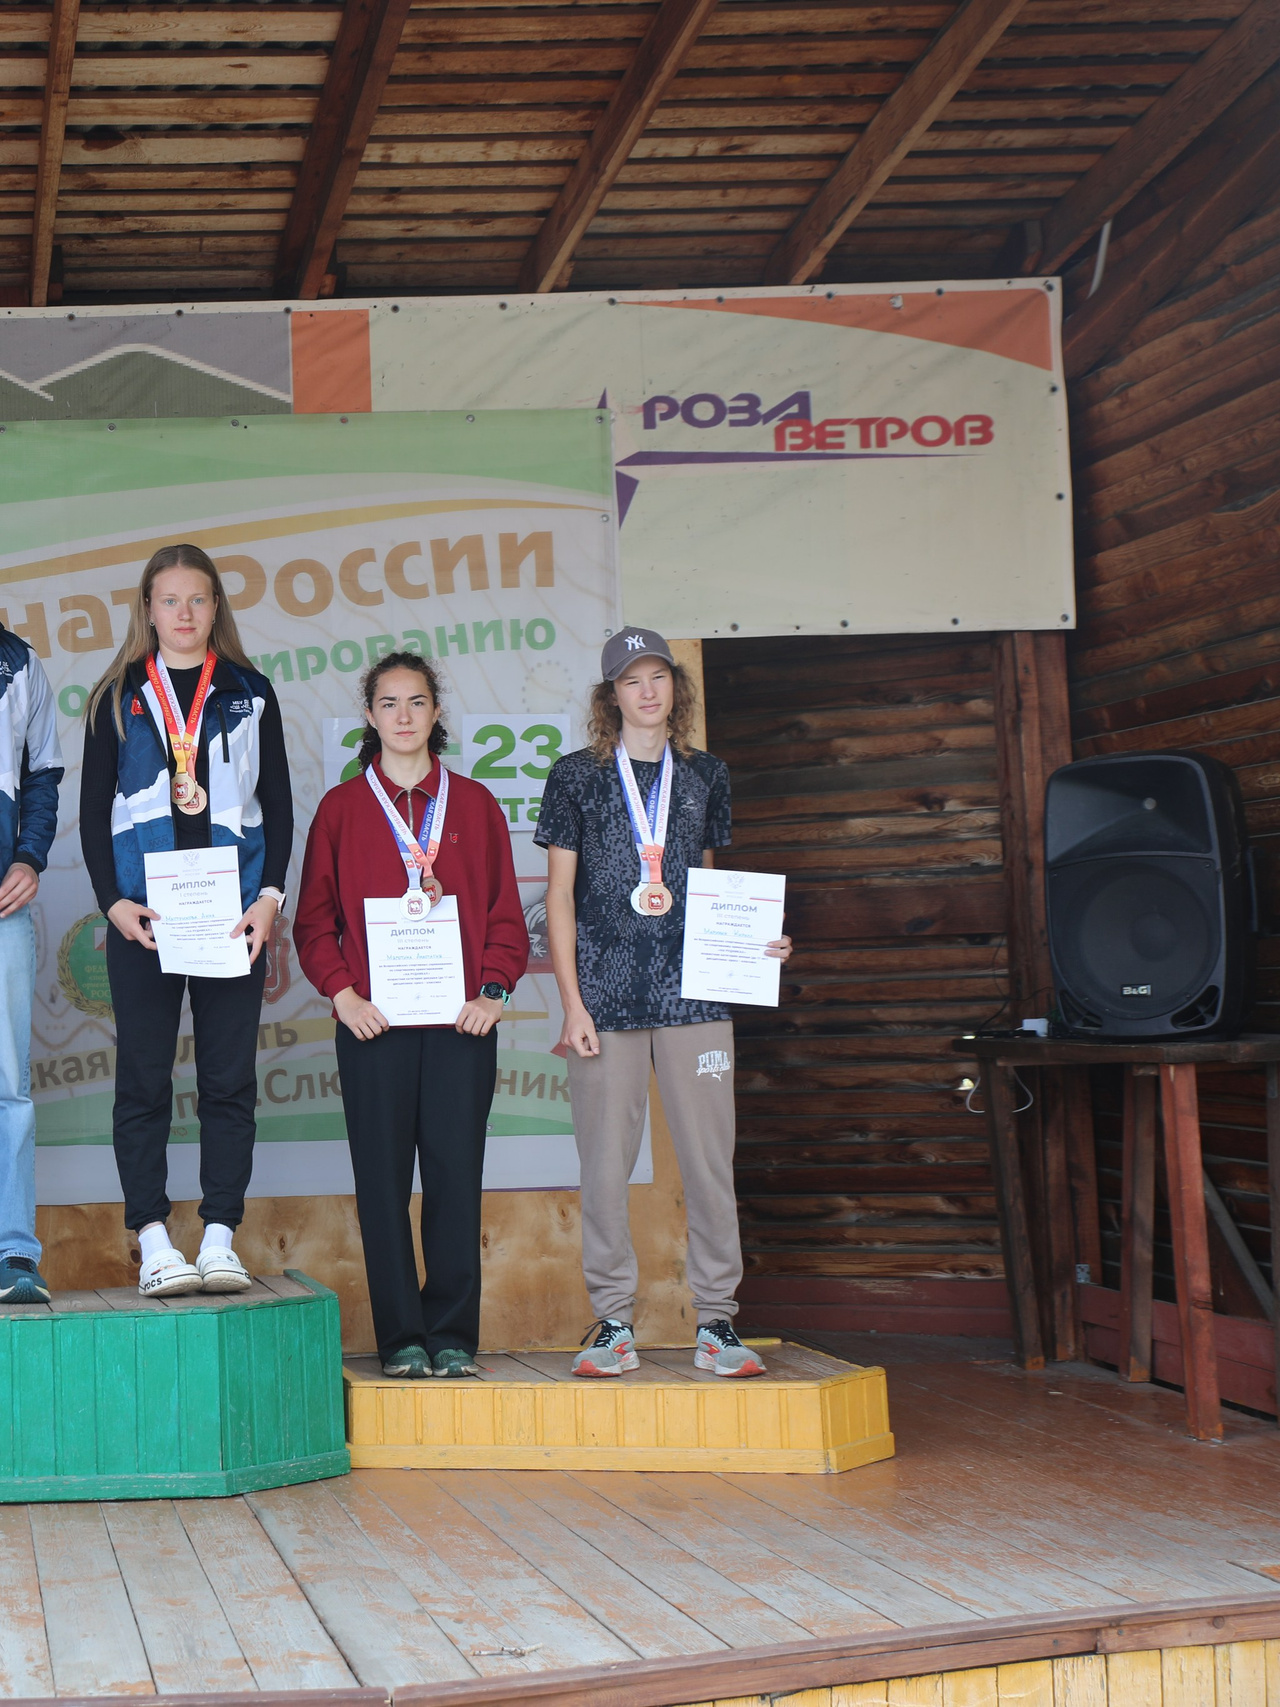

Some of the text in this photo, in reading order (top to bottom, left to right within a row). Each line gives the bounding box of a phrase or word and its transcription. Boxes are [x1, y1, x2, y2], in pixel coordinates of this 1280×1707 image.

[643, 391, 811, 430] РОЗА
[774, 414, 994, 451] ВЕТРОВ
[470, 723, 563, 781] 23
[171, 879, 216, 891] ДИПЛОМ
[710, 902, 758, 913] ДИПЛОМ
[390, 928, 435, 937] ДИПЛОМ
[143, 1277, 163, 1292] rocs
